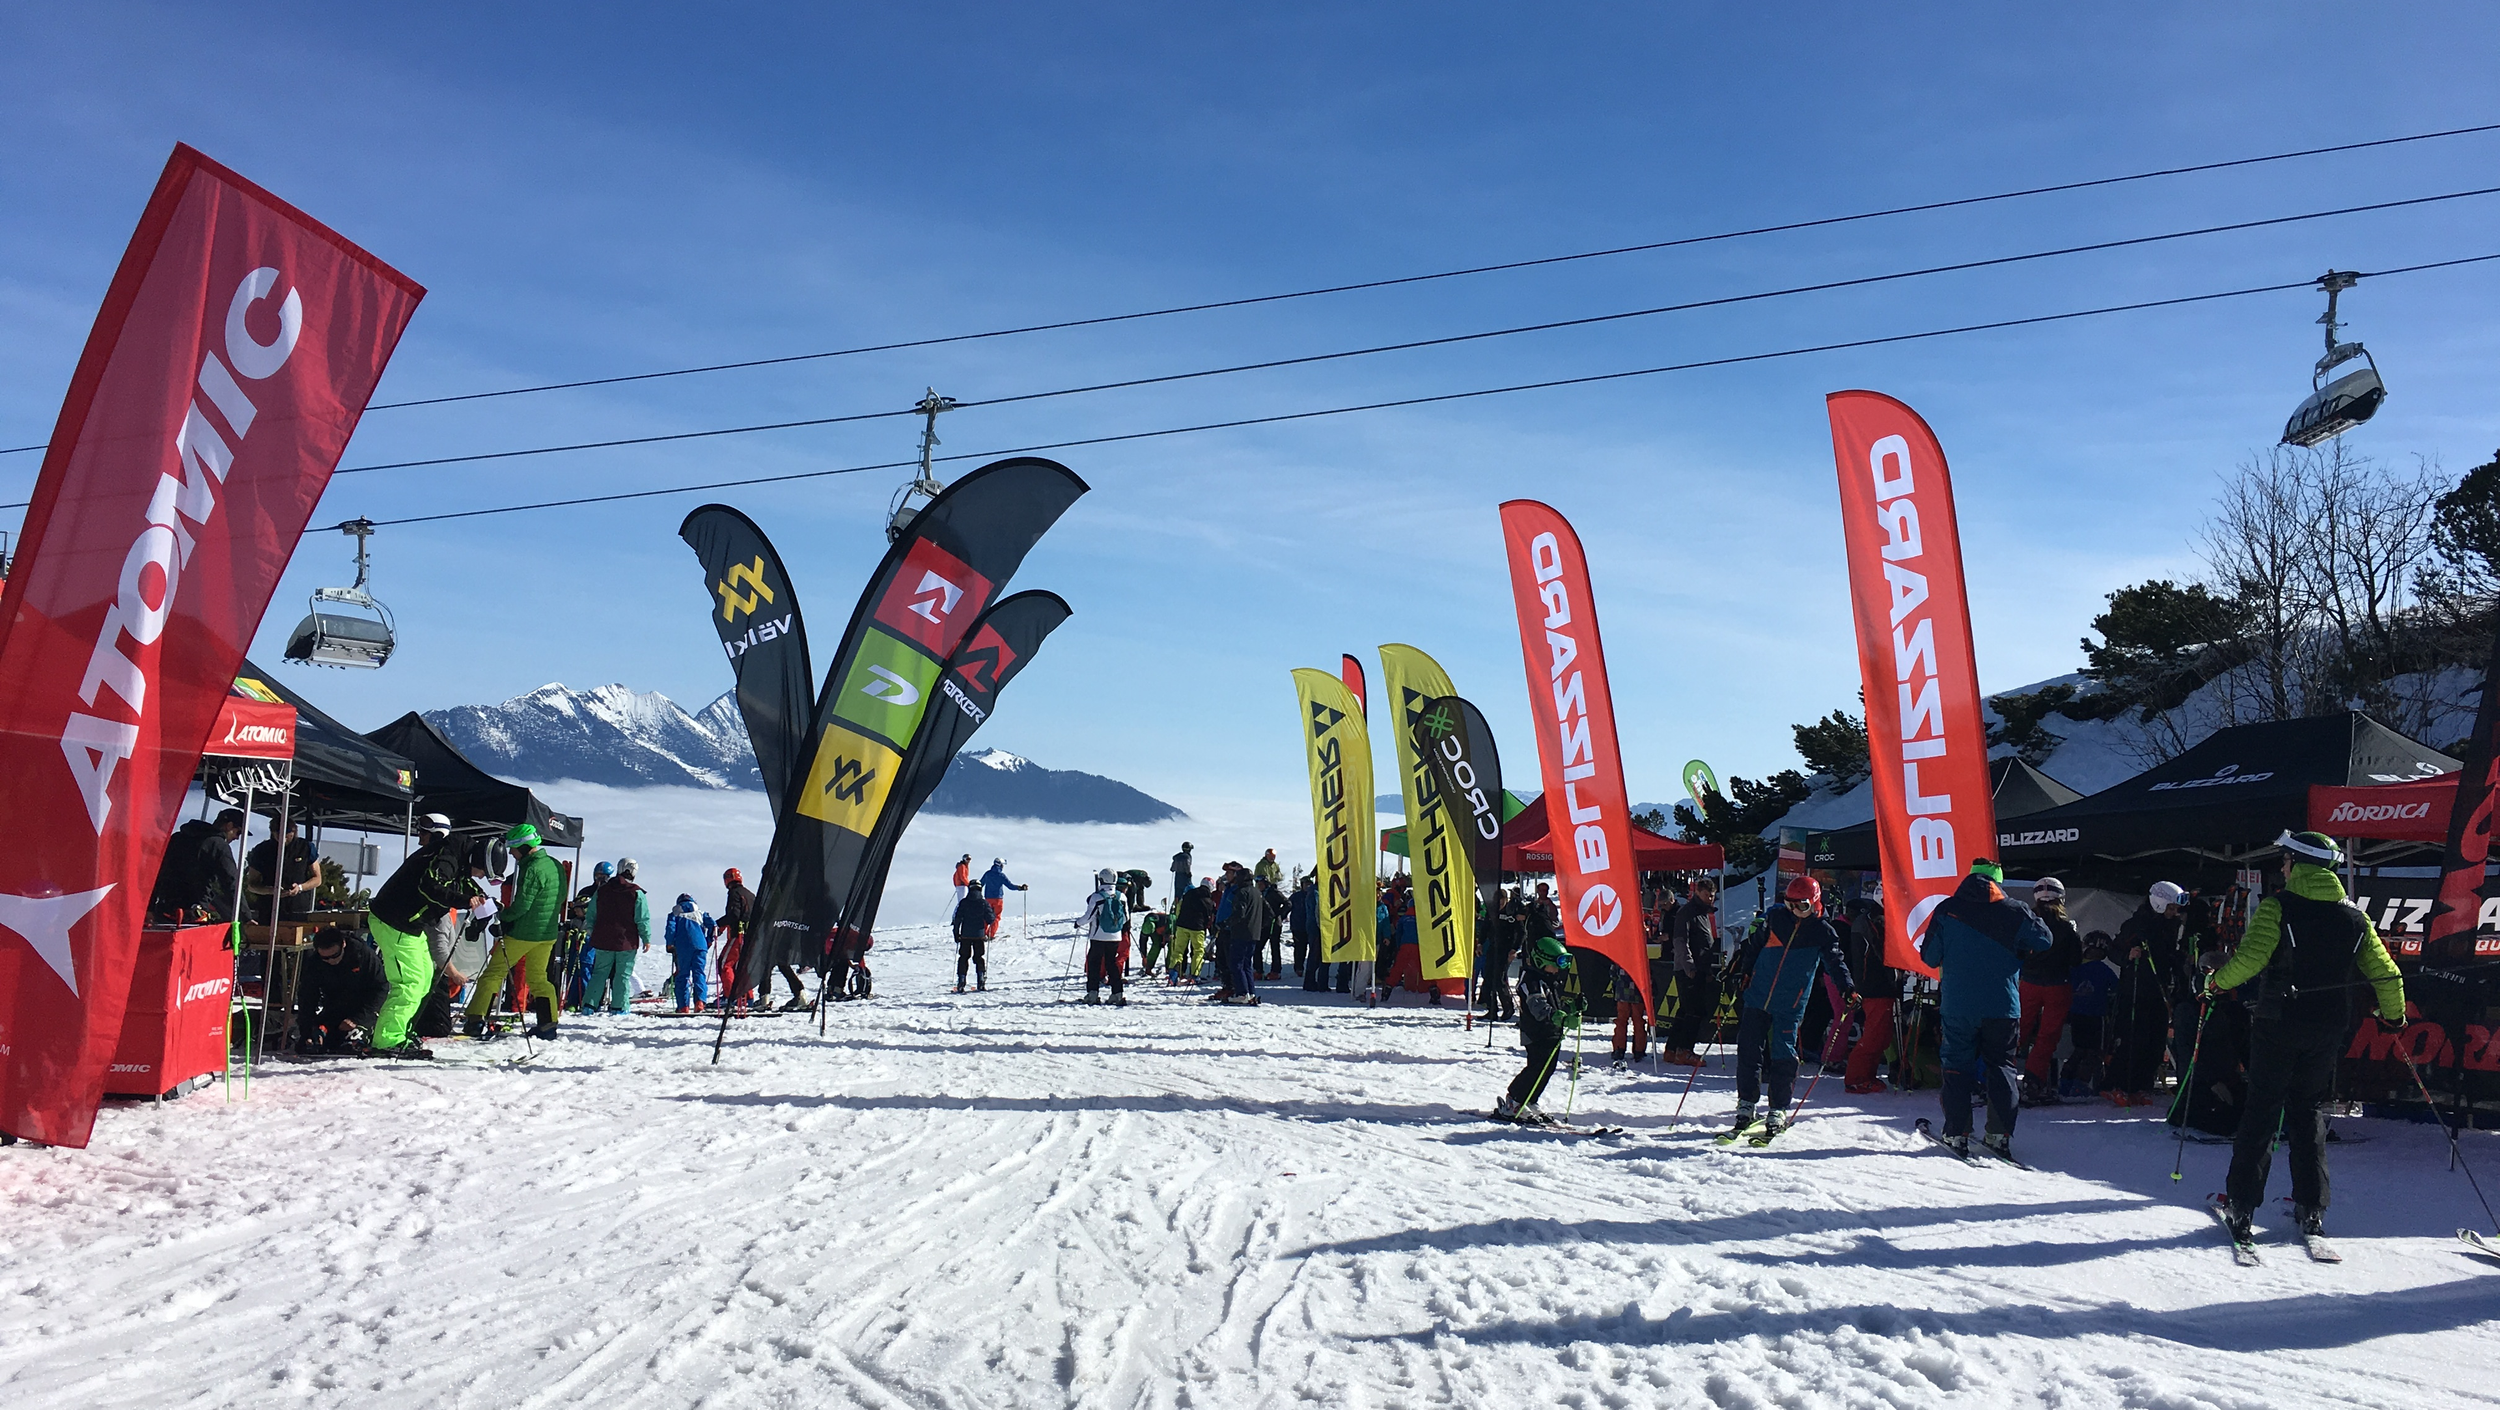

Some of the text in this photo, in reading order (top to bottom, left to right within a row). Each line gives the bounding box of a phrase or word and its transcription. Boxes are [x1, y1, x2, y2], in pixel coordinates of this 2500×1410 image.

[61, 266, 302, 836] ATOMIC
[236, 725, 287, 744] ATOMIC
[2148, 772, 2274, 791] BLIZZARD
[2328, 801, 2431, 823] NORDICA
[2000, 828, 2080, 847] BLIZZARD
[1526, 853, 1553, 862] ROSSIG
[1814, 853, 1835, 862] CROC
[184, 978, 230, 1003] ATOMIC
[110, 1063, 150, 1073] OMIC
